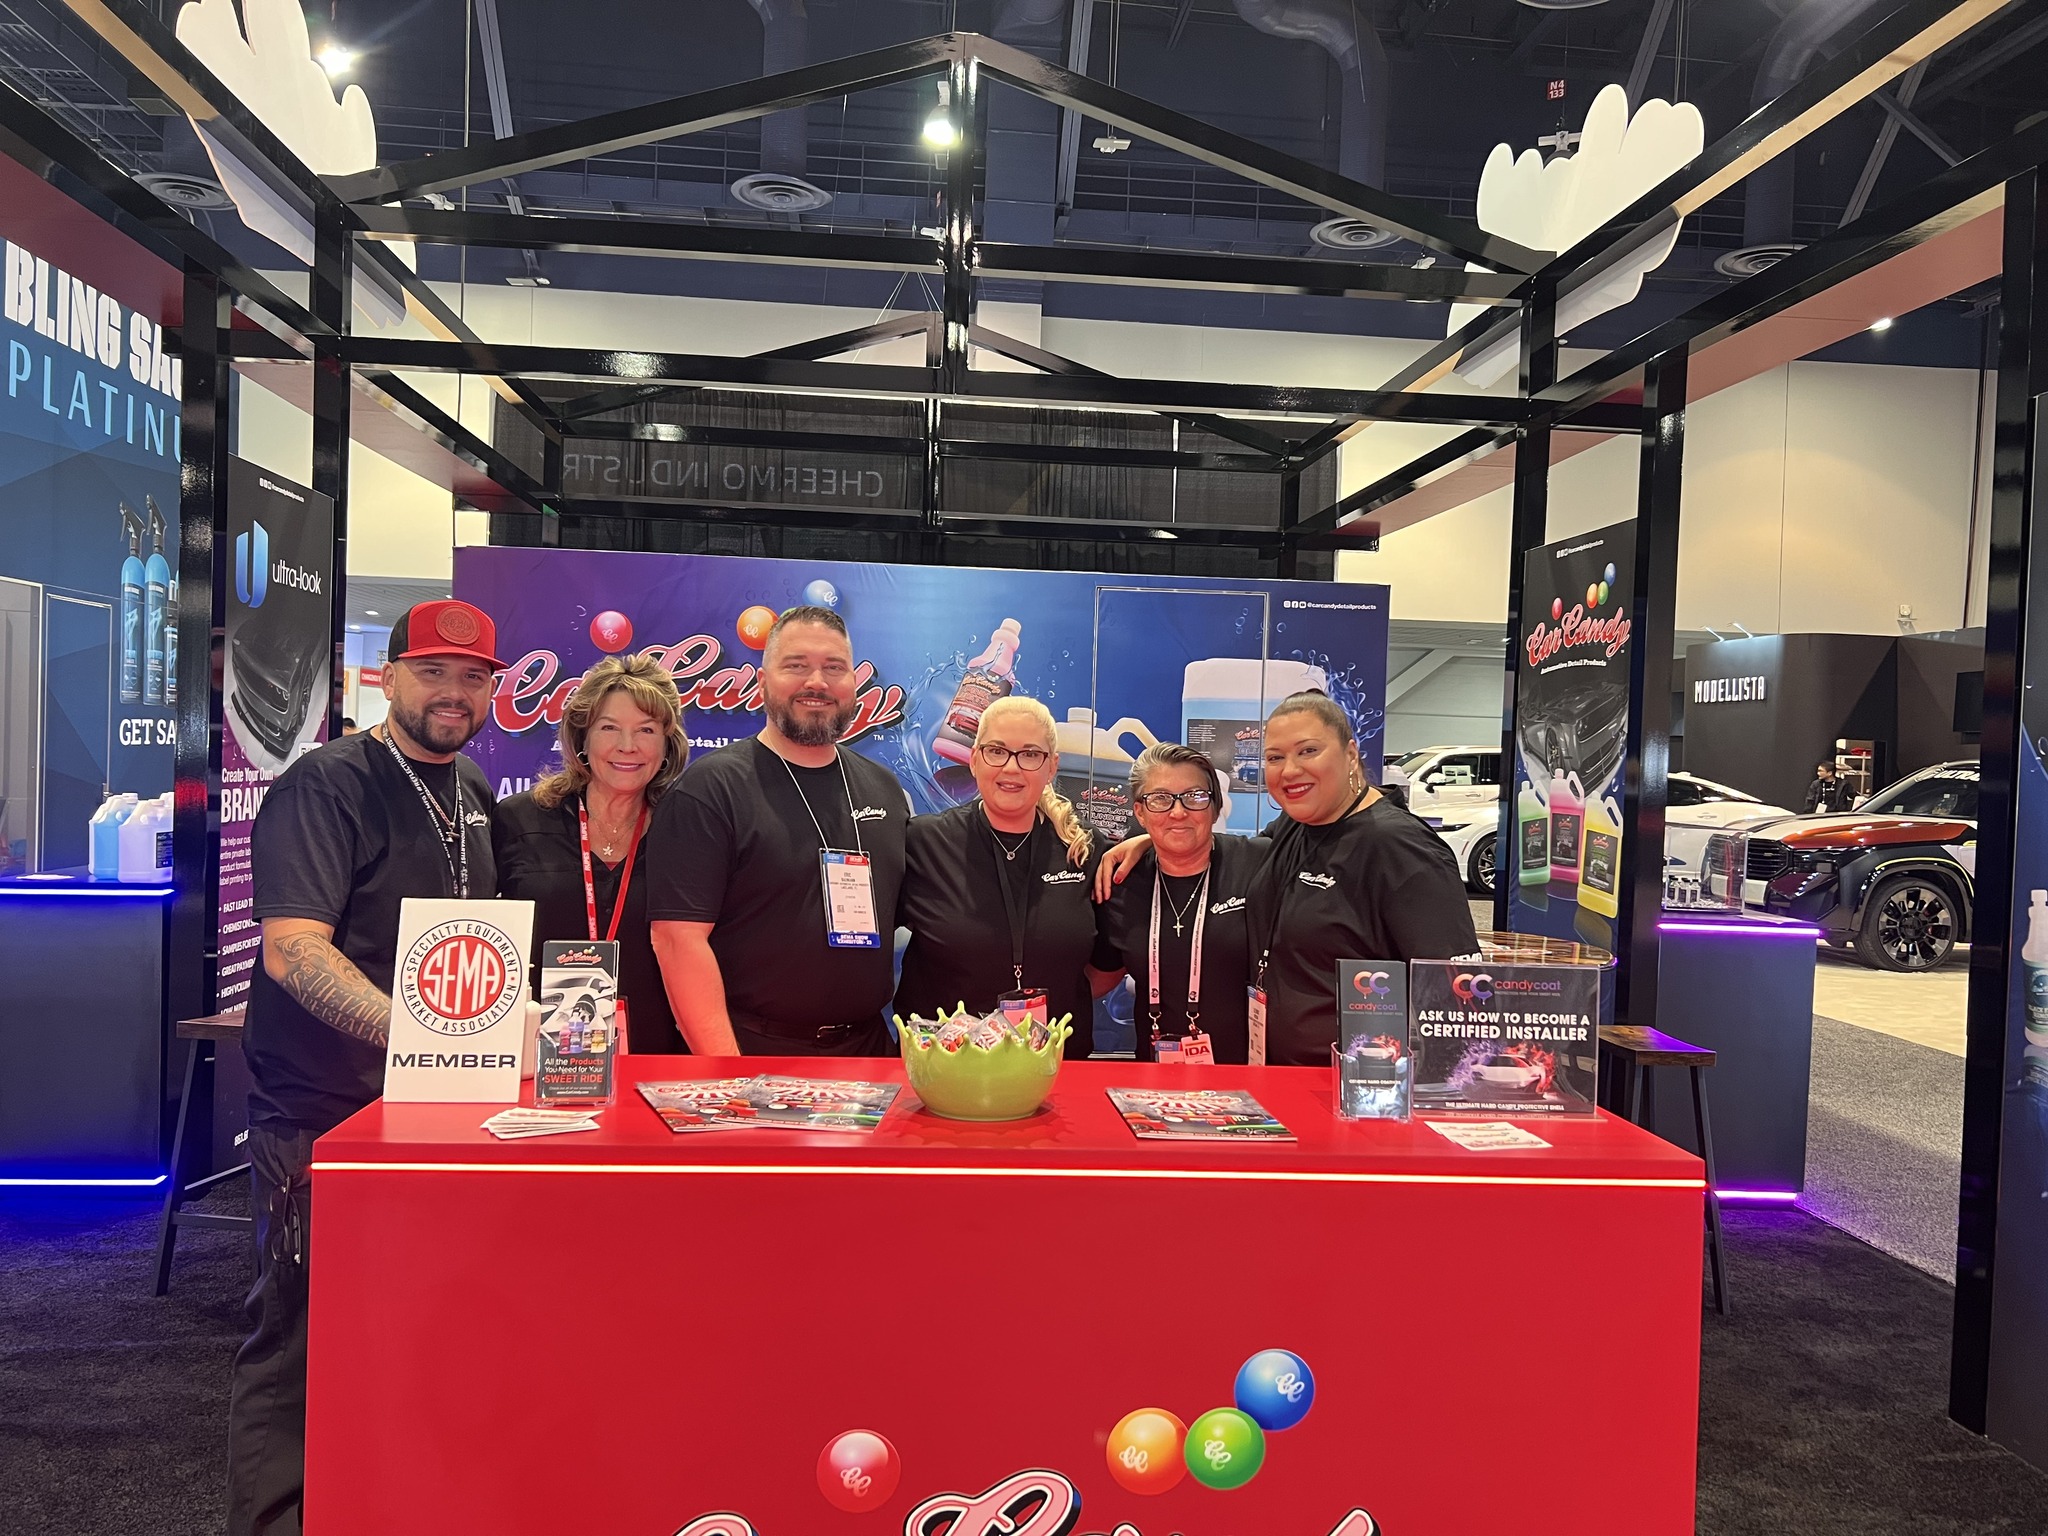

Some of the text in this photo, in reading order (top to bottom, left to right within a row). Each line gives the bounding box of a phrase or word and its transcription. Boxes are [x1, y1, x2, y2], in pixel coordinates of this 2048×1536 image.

[1549, 89, 1565, 99] 133
[4, 240, 122, 370] BLING
[272, 559, 322, 595] ultra-look
[1694, 675, 1765, 704] MODELLISTA
[119, 719, 153, 746] GET
[686, 736, 729, 748] etail
[222, 767, 244, 784] Create
[244, 767, 259, 786] Your
[497, 777, 531, 804] All
[221, 786, 270, 824] BRAN
[406, 923, 518, 973] SPECIALTY EQUIPMENT
[422, 940, 500, 1015] SEMA
[404, 983, 518, 1033] MARKET ASSOCIATION
[1418, 1010, 1591, 1026] ASK US HOW TO BECOME A
[1419, 1023, 1588, 1041] CERTIFIED INSTALLER
[392, 1053, 516, 1069] MEMBER
[544, 1058, 554, 1066] All
[570, 1058, 604, 1066] Products
[1184, 1045, 1210, 1057] IDA
[544, 1074, 603, 1083] SWEET RIDE
